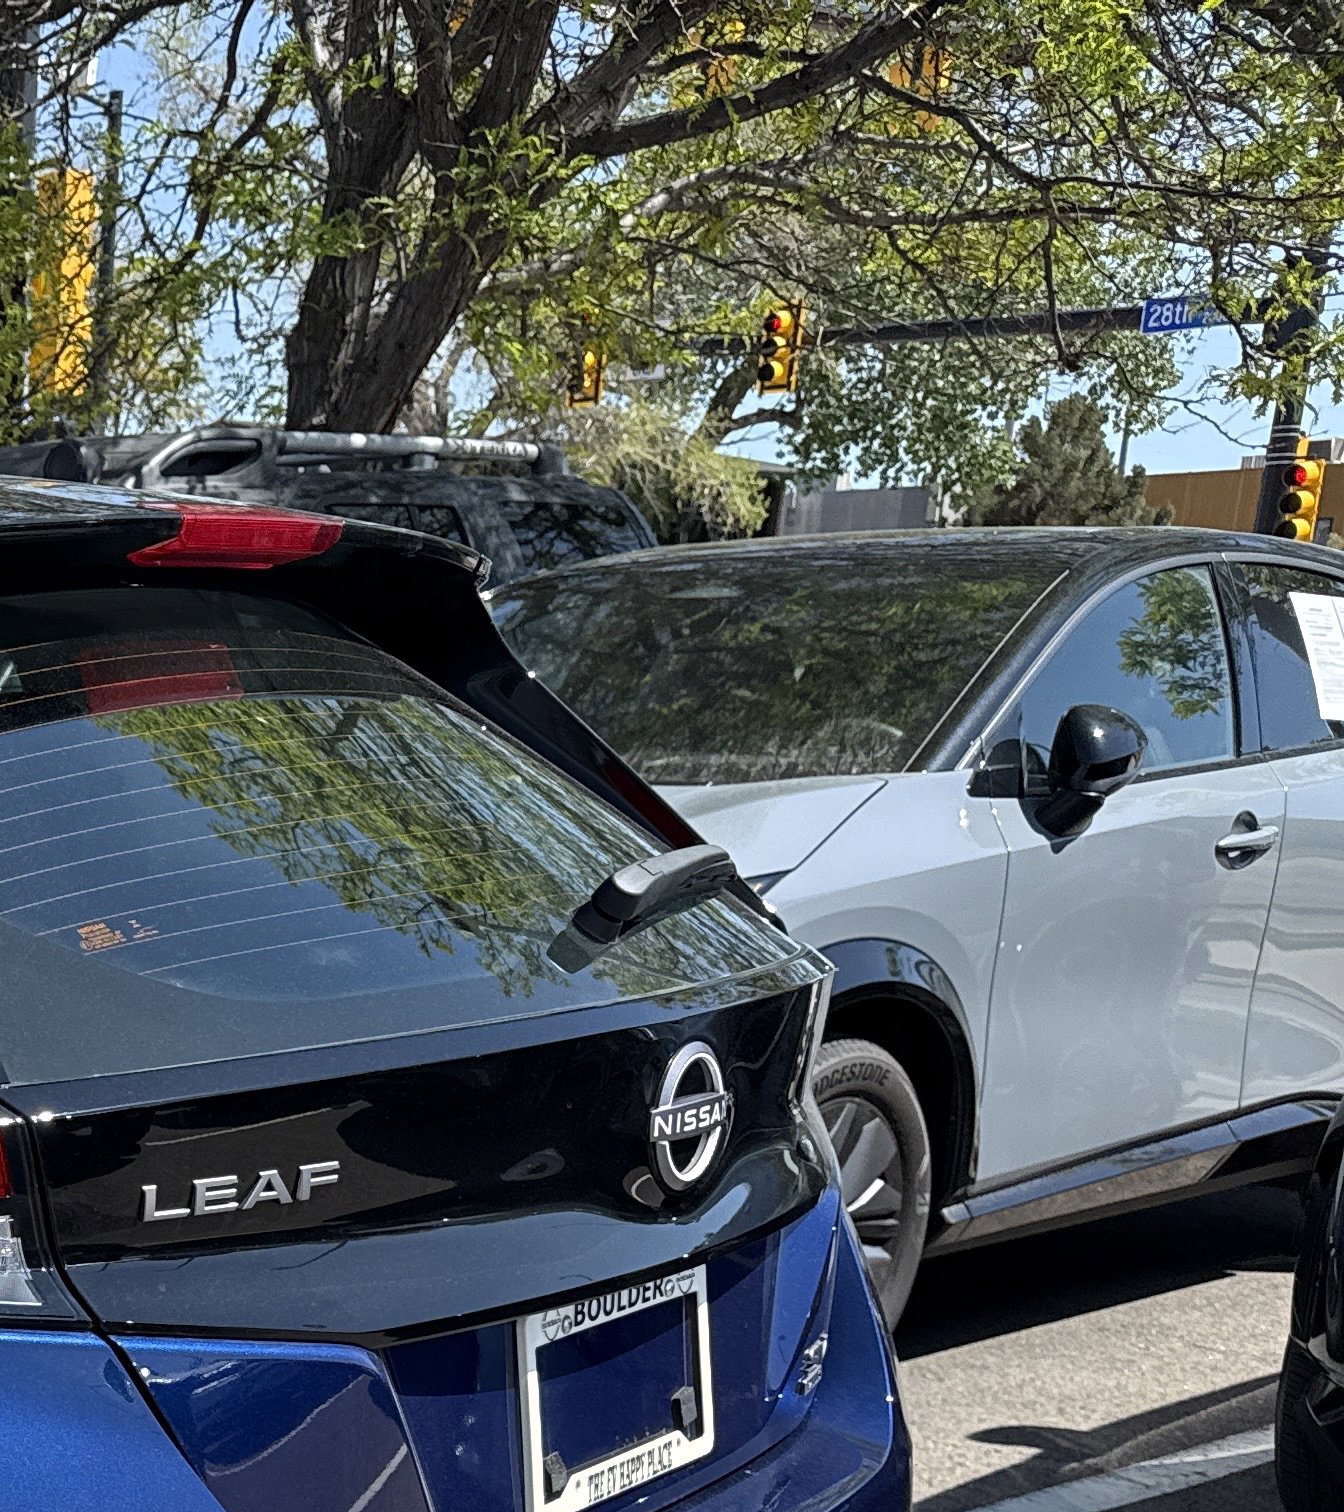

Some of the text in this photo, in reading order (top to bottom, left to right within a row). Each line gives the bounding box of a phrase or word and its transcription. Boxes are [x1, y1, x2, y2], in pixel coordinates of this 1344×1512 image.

[141, 1160, 340, 1222] LEAF
[574, 1278, 664, 1327] BOULDER
[619, 1451, 646, 1490] HAPPY
[647, 1440, 673, 1477] PLACE
